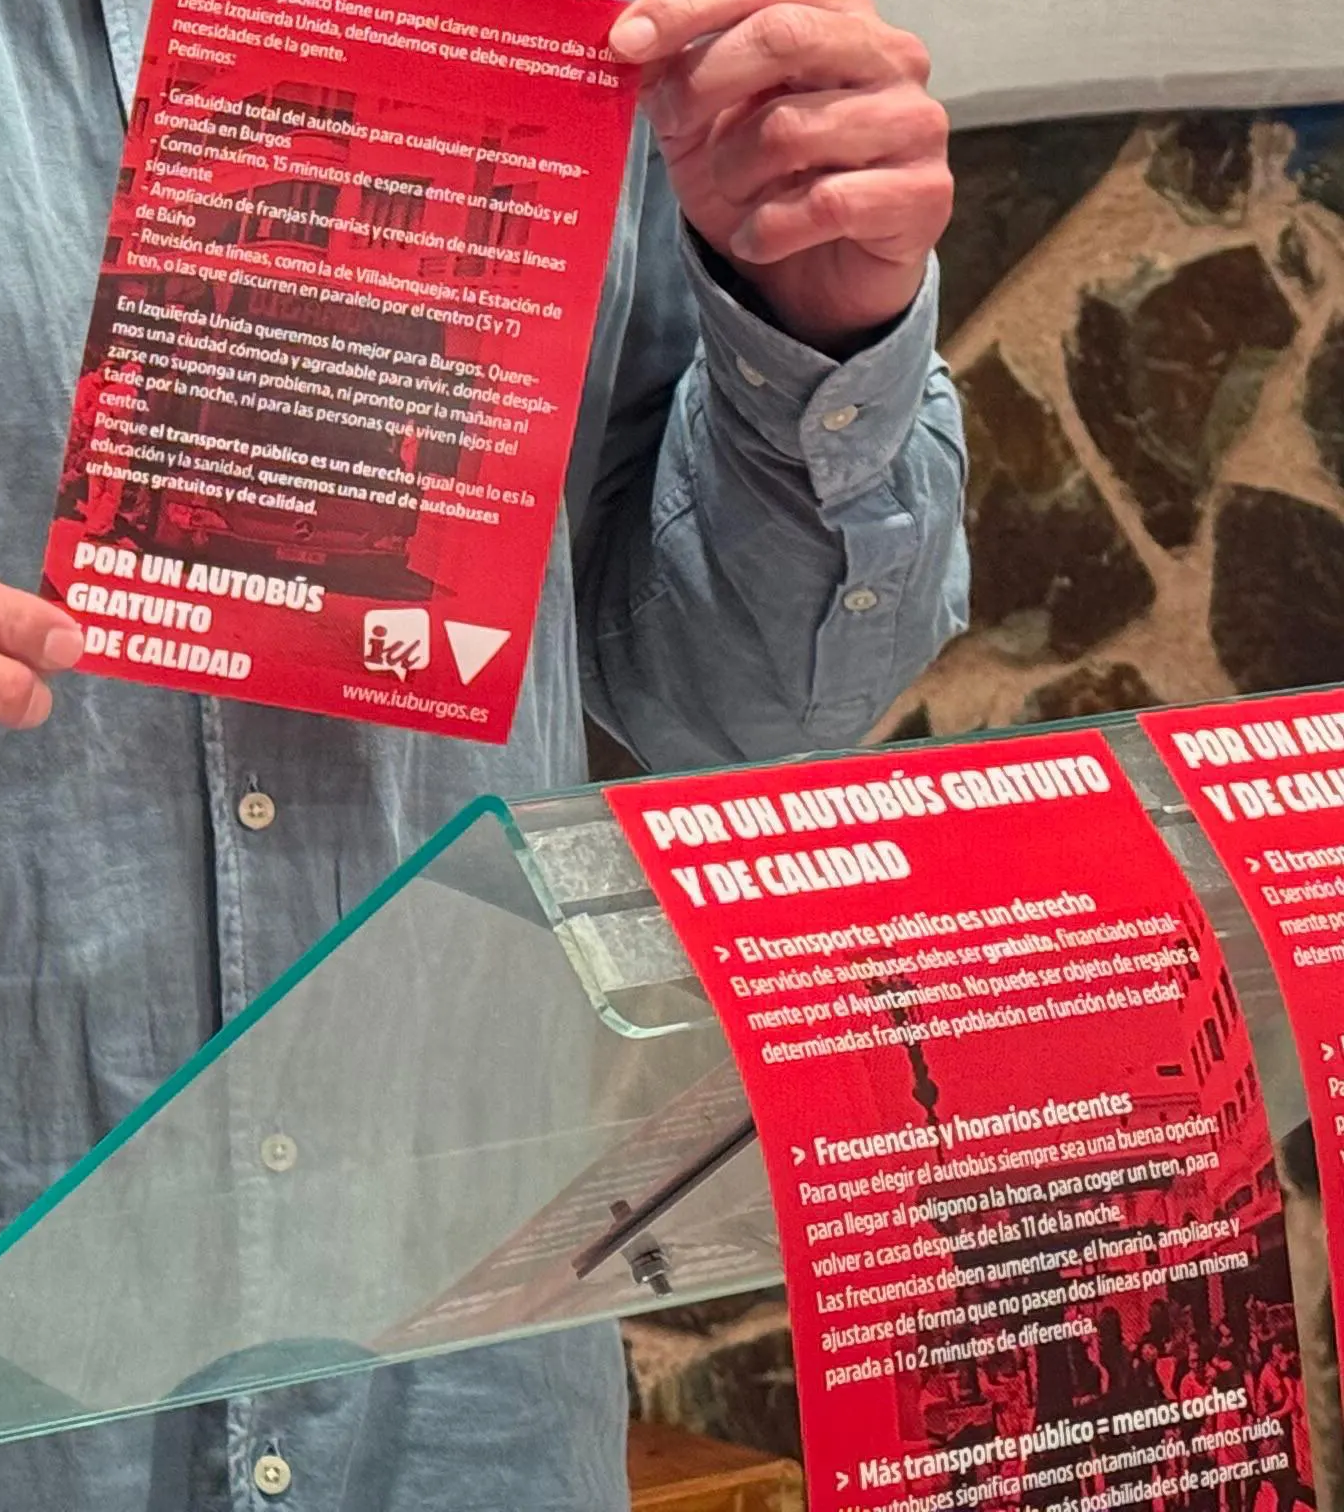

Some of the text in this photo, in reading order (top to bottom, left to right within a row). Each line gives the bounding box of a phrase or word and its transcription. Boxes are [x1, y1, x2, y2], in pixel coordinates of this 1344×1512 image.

[171, 18, 262, 46] necesidades
[262, 32, 283, 50] de
[283, 35, 299, 53] la
[223, 0, 294, 28] Izquierda
[343, 22, 438, 54] defendemos
[437, 42, 469, 60] que
[468, 45, 508, 68] debe
[507, 55, 585, 81] responder
[585, 70, 597, 84] a
[597, 68, 619, 88] las
[153, 109, 292, 149] dronada en Burgos
[143, 155, 213, 183] siguiente
[116, 294, 136, 313] En
[137, 298, 208, 326] Izquierda
[253, 323, 330, 349] queremos
[329, 333, 346, 352] lo
[346, 340, 392, 360] mejor
[391, 349, 428, 366] para
[84, 459, 317, 516] urbanos gratuitos y de calidad.
[72, 540, 325, 613] POR UN AUTOBÚS
[65, 581, 212, 633] GRATUITO
[82, 624, 252, 680] DE CALIDAD
[342, 683, 490, 723] www.iuburgos.es
[1170, 726, 1255, 769] POR
[1240, 720, 1302, 761] UN
[641, 754, 1111, 850] POR UN AUTOBÚS GRATUITO
[1200, 784, 1236, 823] Y
[1228, 777, 1286, 820] DE
[669, 839, 911, 907] Y DE CALIDAD
[734, 889, 1097, 963] El transporte público es un derecho
[812, 1091, 1133, 1166] Frecuencias y horarios decentes
[858, 1456, 902, 1490] Más
[902, 1434, 1018, 1480] transporte
[1017, 1417, 1094, 1462] público
[1111, 1401, 1181, 1435] menos
[1180, 1385, 1248, 1420] coches
